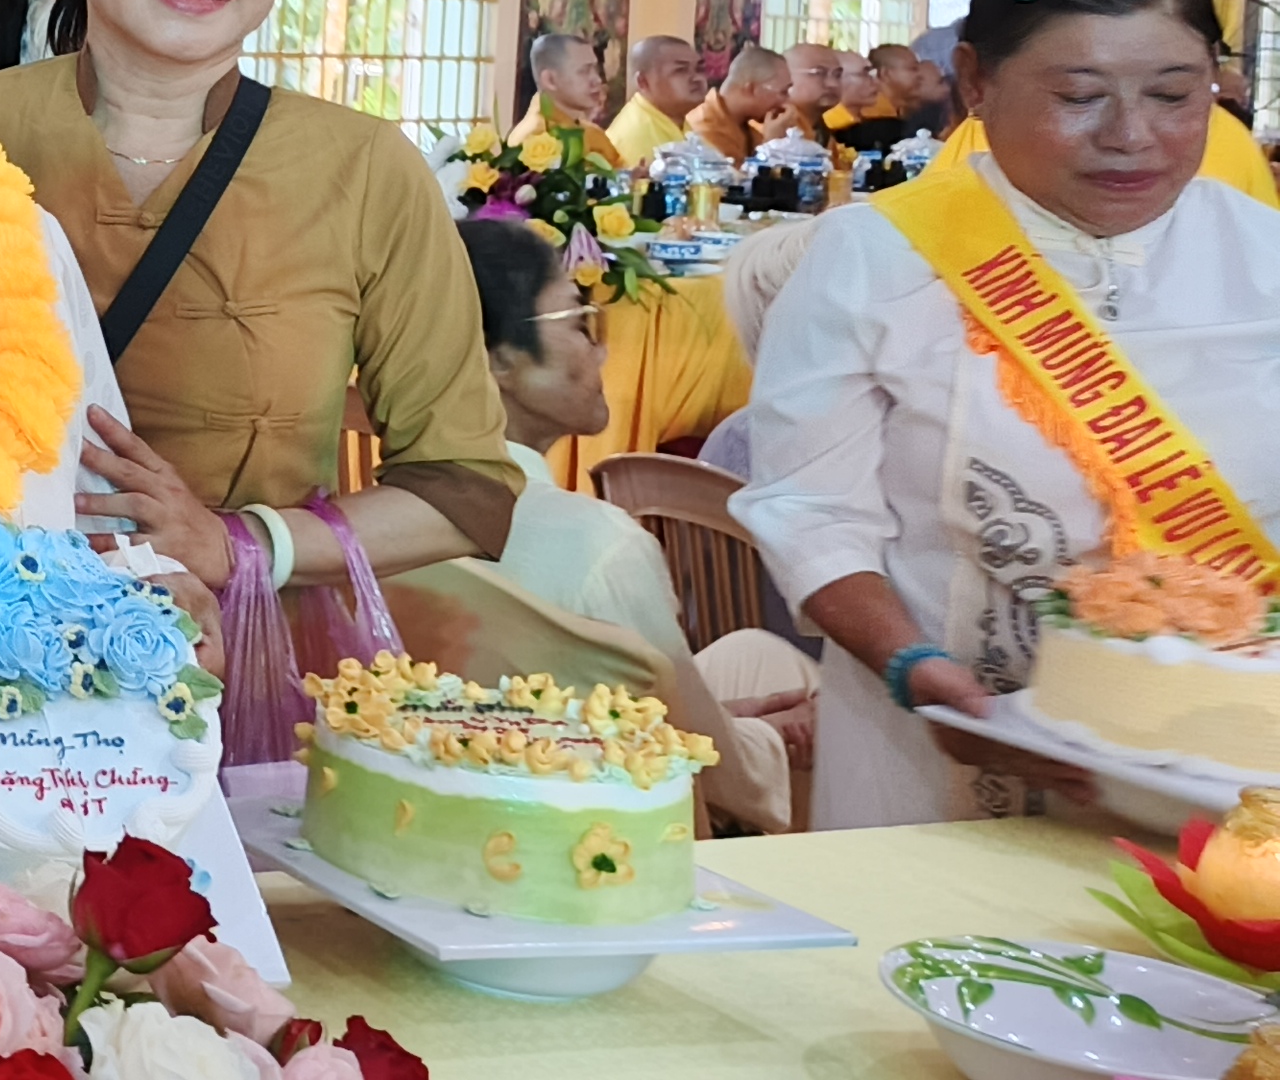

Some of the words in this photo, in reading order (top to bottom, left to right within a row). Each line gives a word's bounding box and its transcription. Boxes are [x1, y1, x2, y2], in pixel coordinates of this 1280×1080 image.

[961, 244, 1060, 325] KÍNH
[1151, 487, 1232, 544] VU
[73, 729, 125, 755] Thọ
